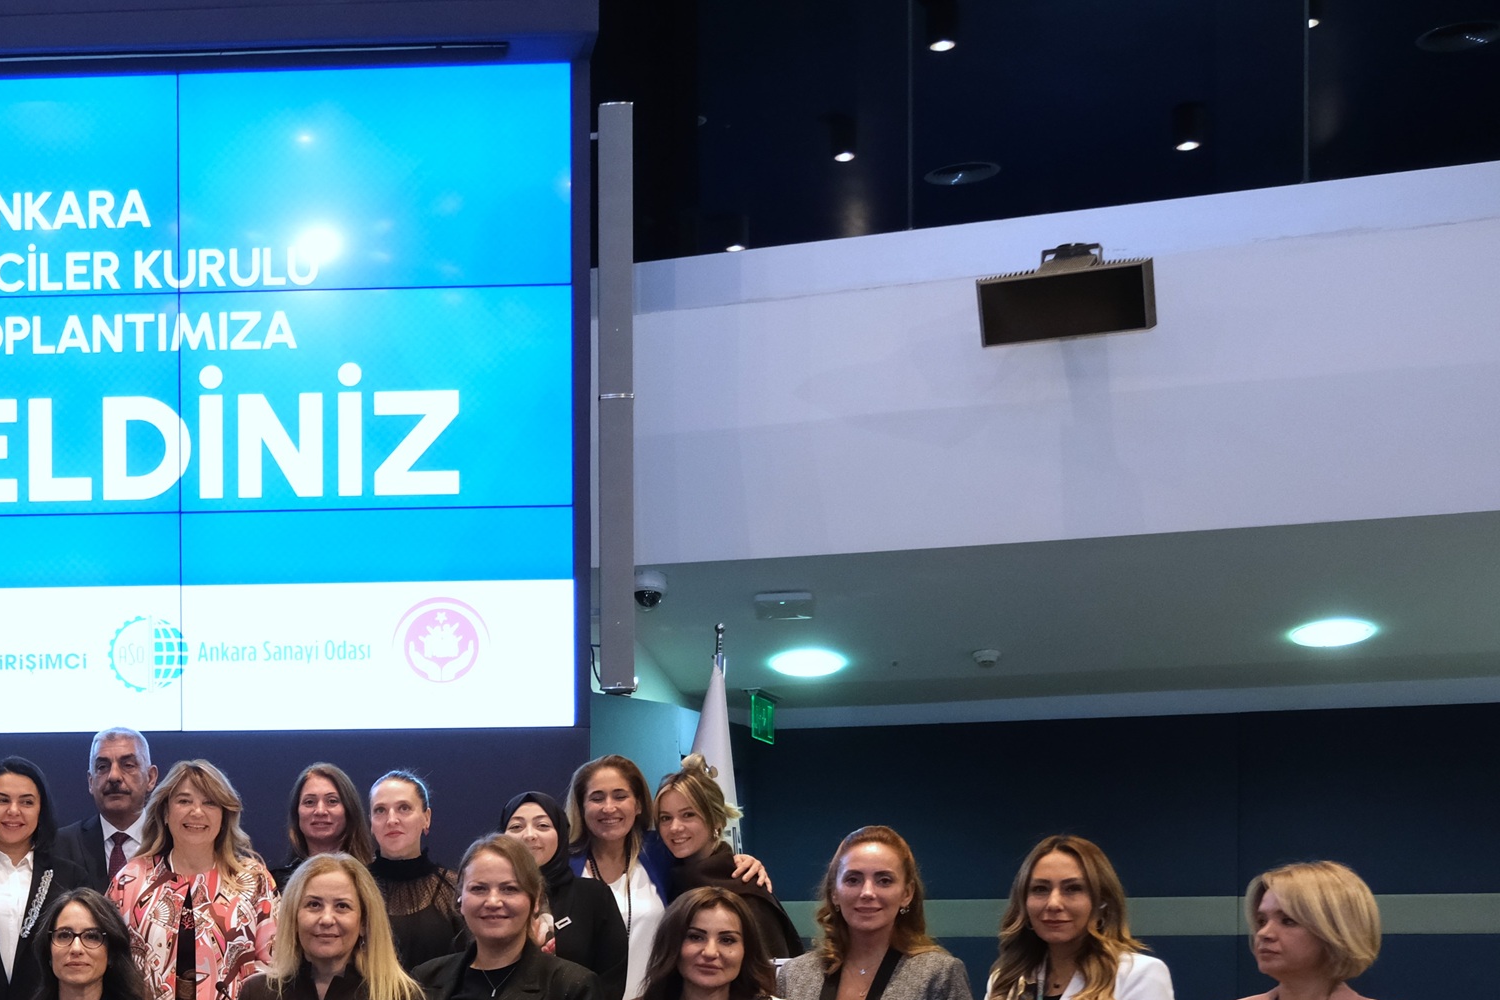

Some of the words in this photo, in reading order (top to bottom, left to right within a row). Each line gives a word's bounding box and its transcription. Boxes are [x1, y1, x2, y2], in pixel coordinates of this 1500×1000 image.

[134, 246, 320, 290] KURULU
[197, 641, 259, 663] Ankara
[262, 639, 320, 665] Sanayi
[324, 639, 373, 662] Odası
